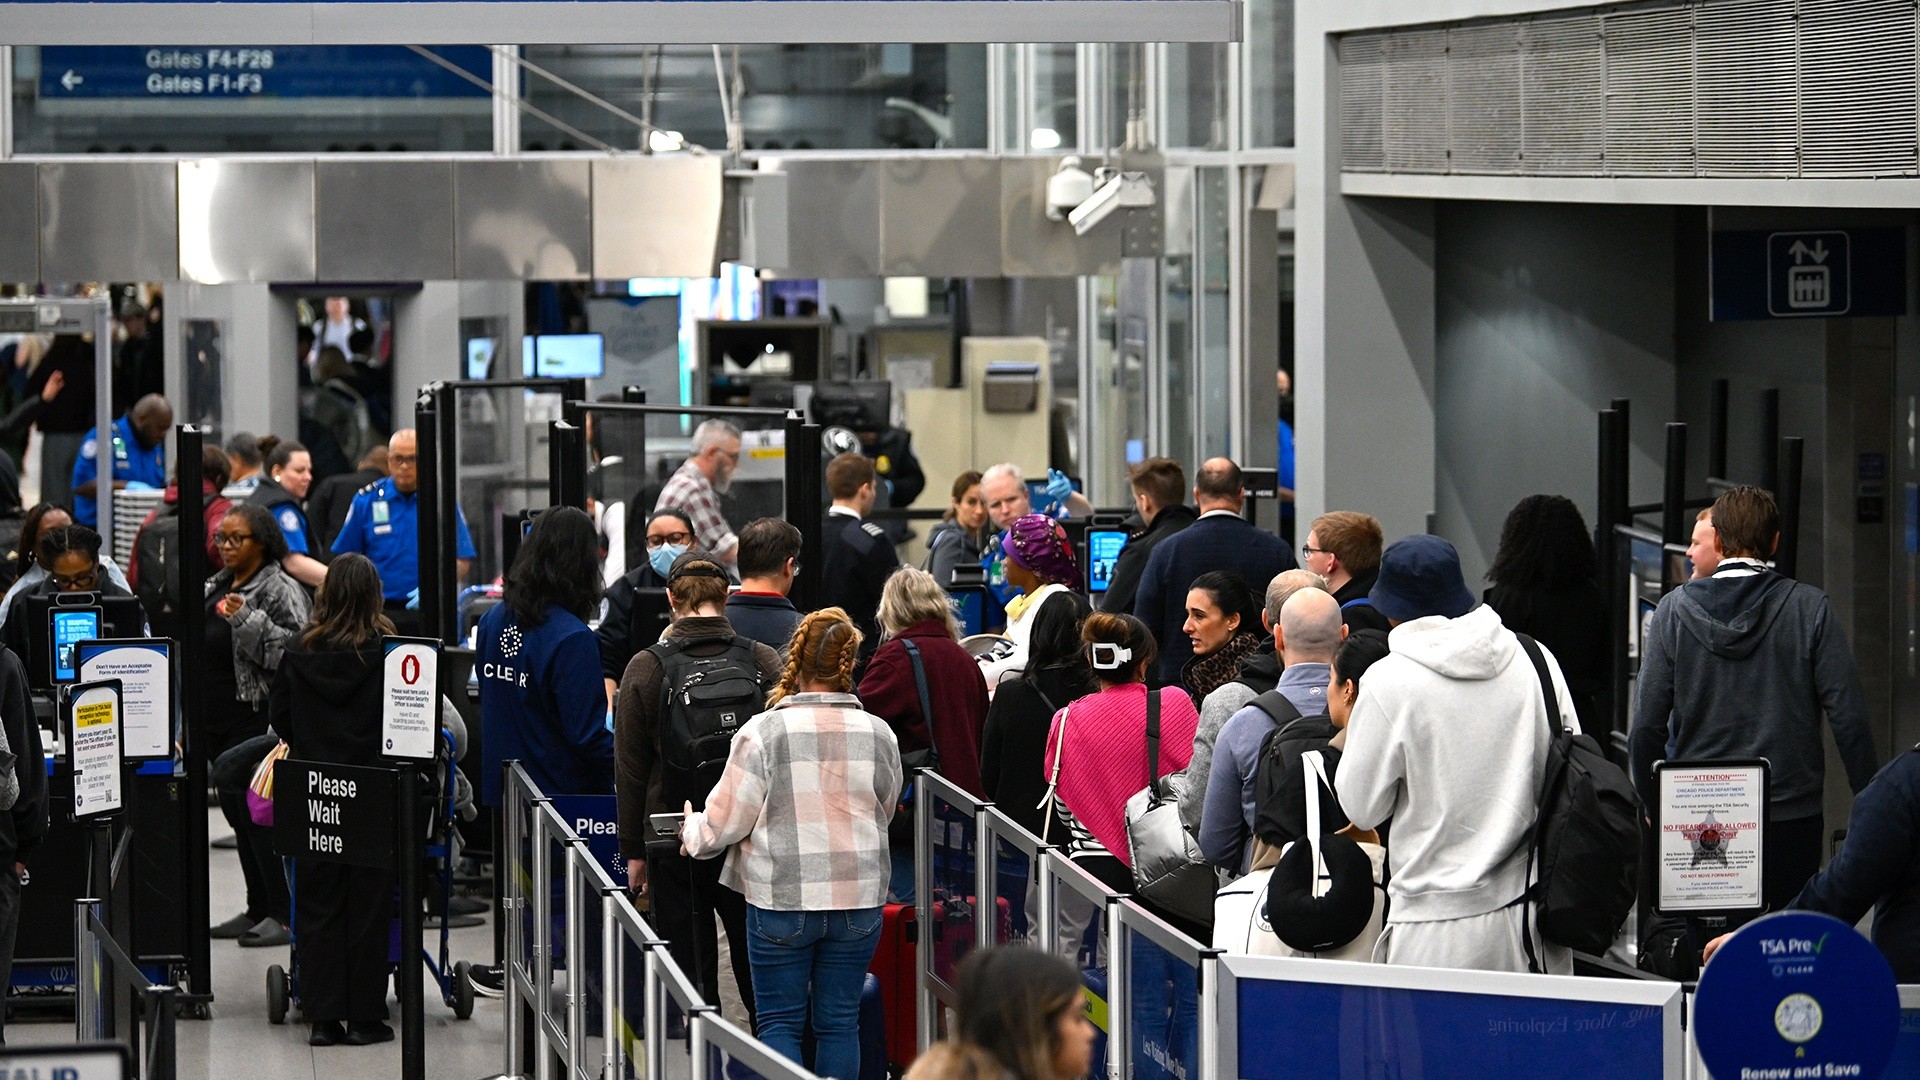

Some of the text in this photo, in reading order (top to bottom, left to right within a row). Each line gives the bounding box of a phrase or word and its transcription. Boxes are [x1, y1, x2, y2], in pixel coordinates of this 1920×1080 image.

[146, 49, 274, 69] Gates F4-F28
[147, 73, 263, 93] Gates F1-F3
[484, 663, 526, 688] CLER
[308, 770, 357, 798] Please
[308, 798, 340, 825] Wait
[576, 818, 618, 835] Plea
[309, 827, 343, 854] Here
[1760, 938, 1812, 954] TSA Pre
[1741, 1062, 1860, 1080] Renew and Save
